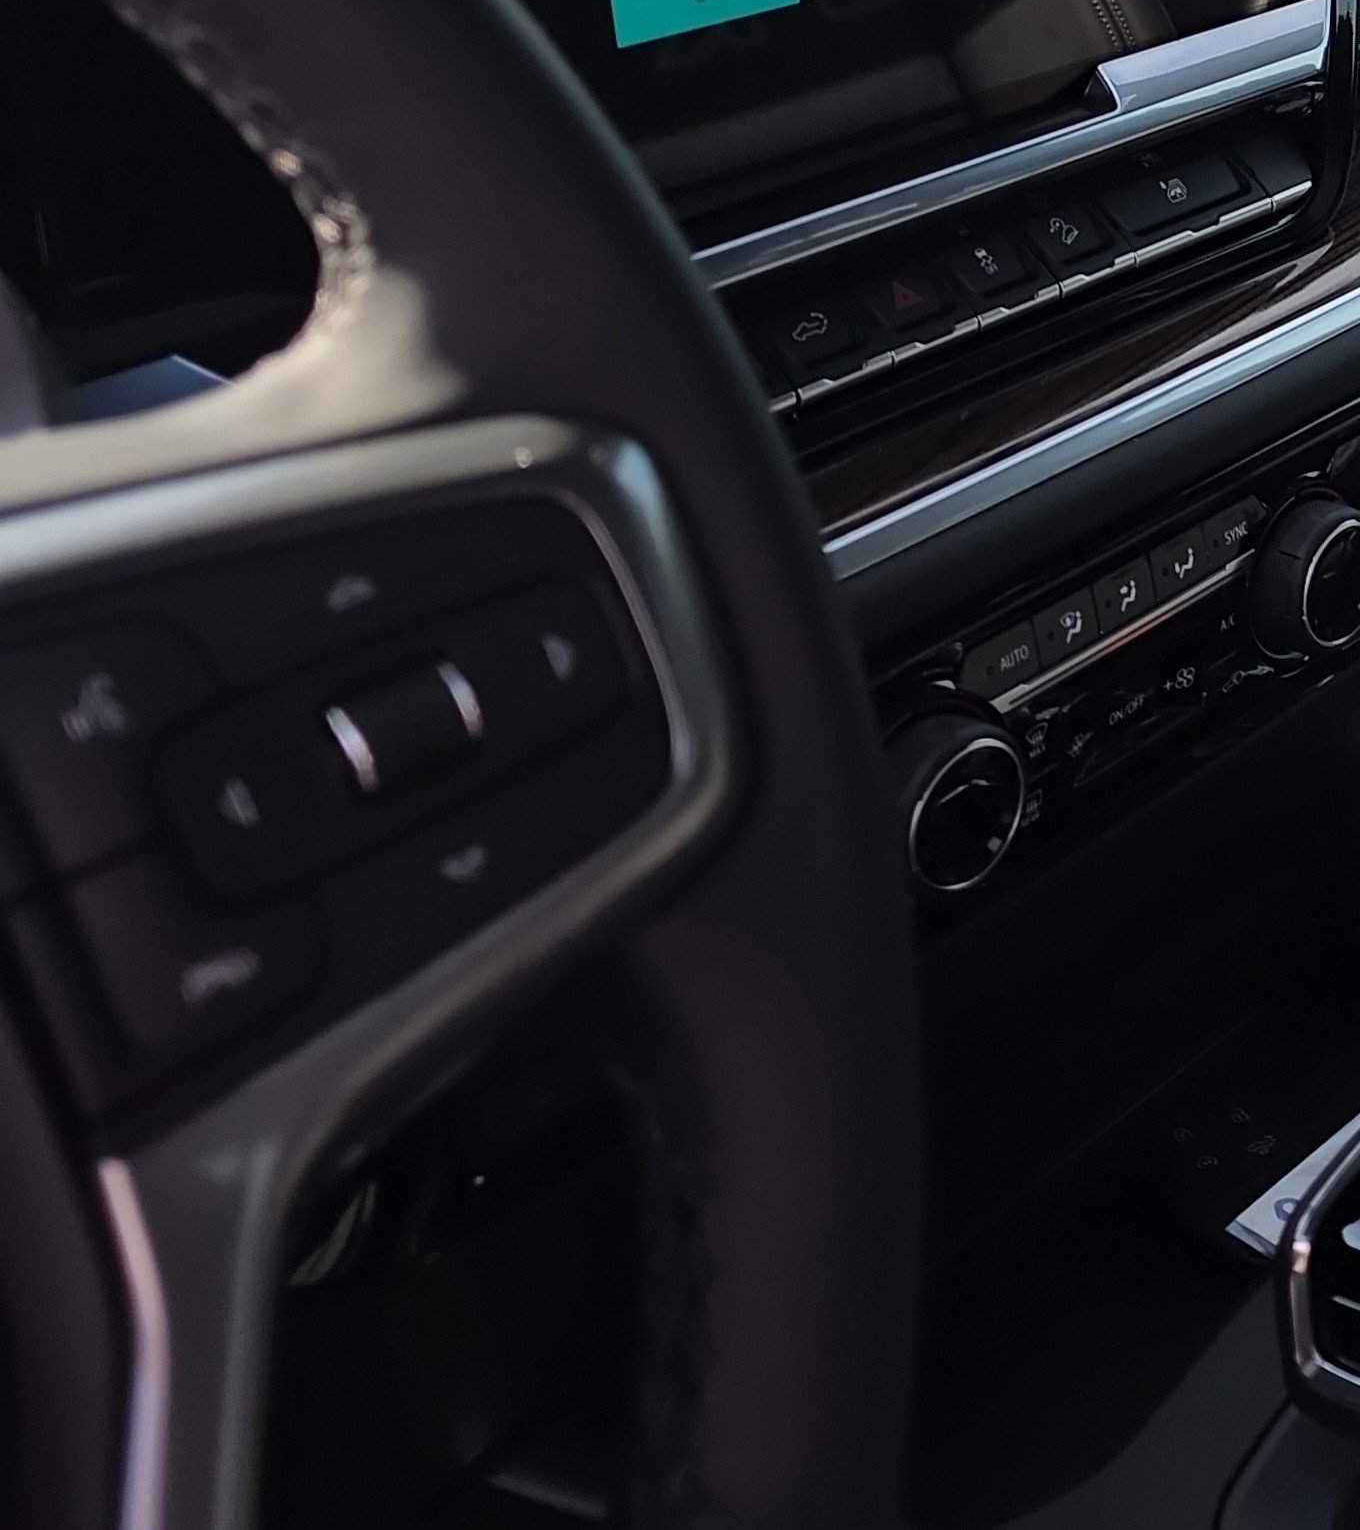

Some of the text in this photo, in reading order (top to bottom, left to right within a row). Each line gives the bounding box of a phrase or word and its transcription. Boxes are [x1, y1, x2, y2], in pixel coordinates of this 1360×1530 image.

[1224, 520, 1249, 546] SYNC
[1000, 644, 1030, 672] AUTO
[1108, 694, 1148, 726] ON/OFF
